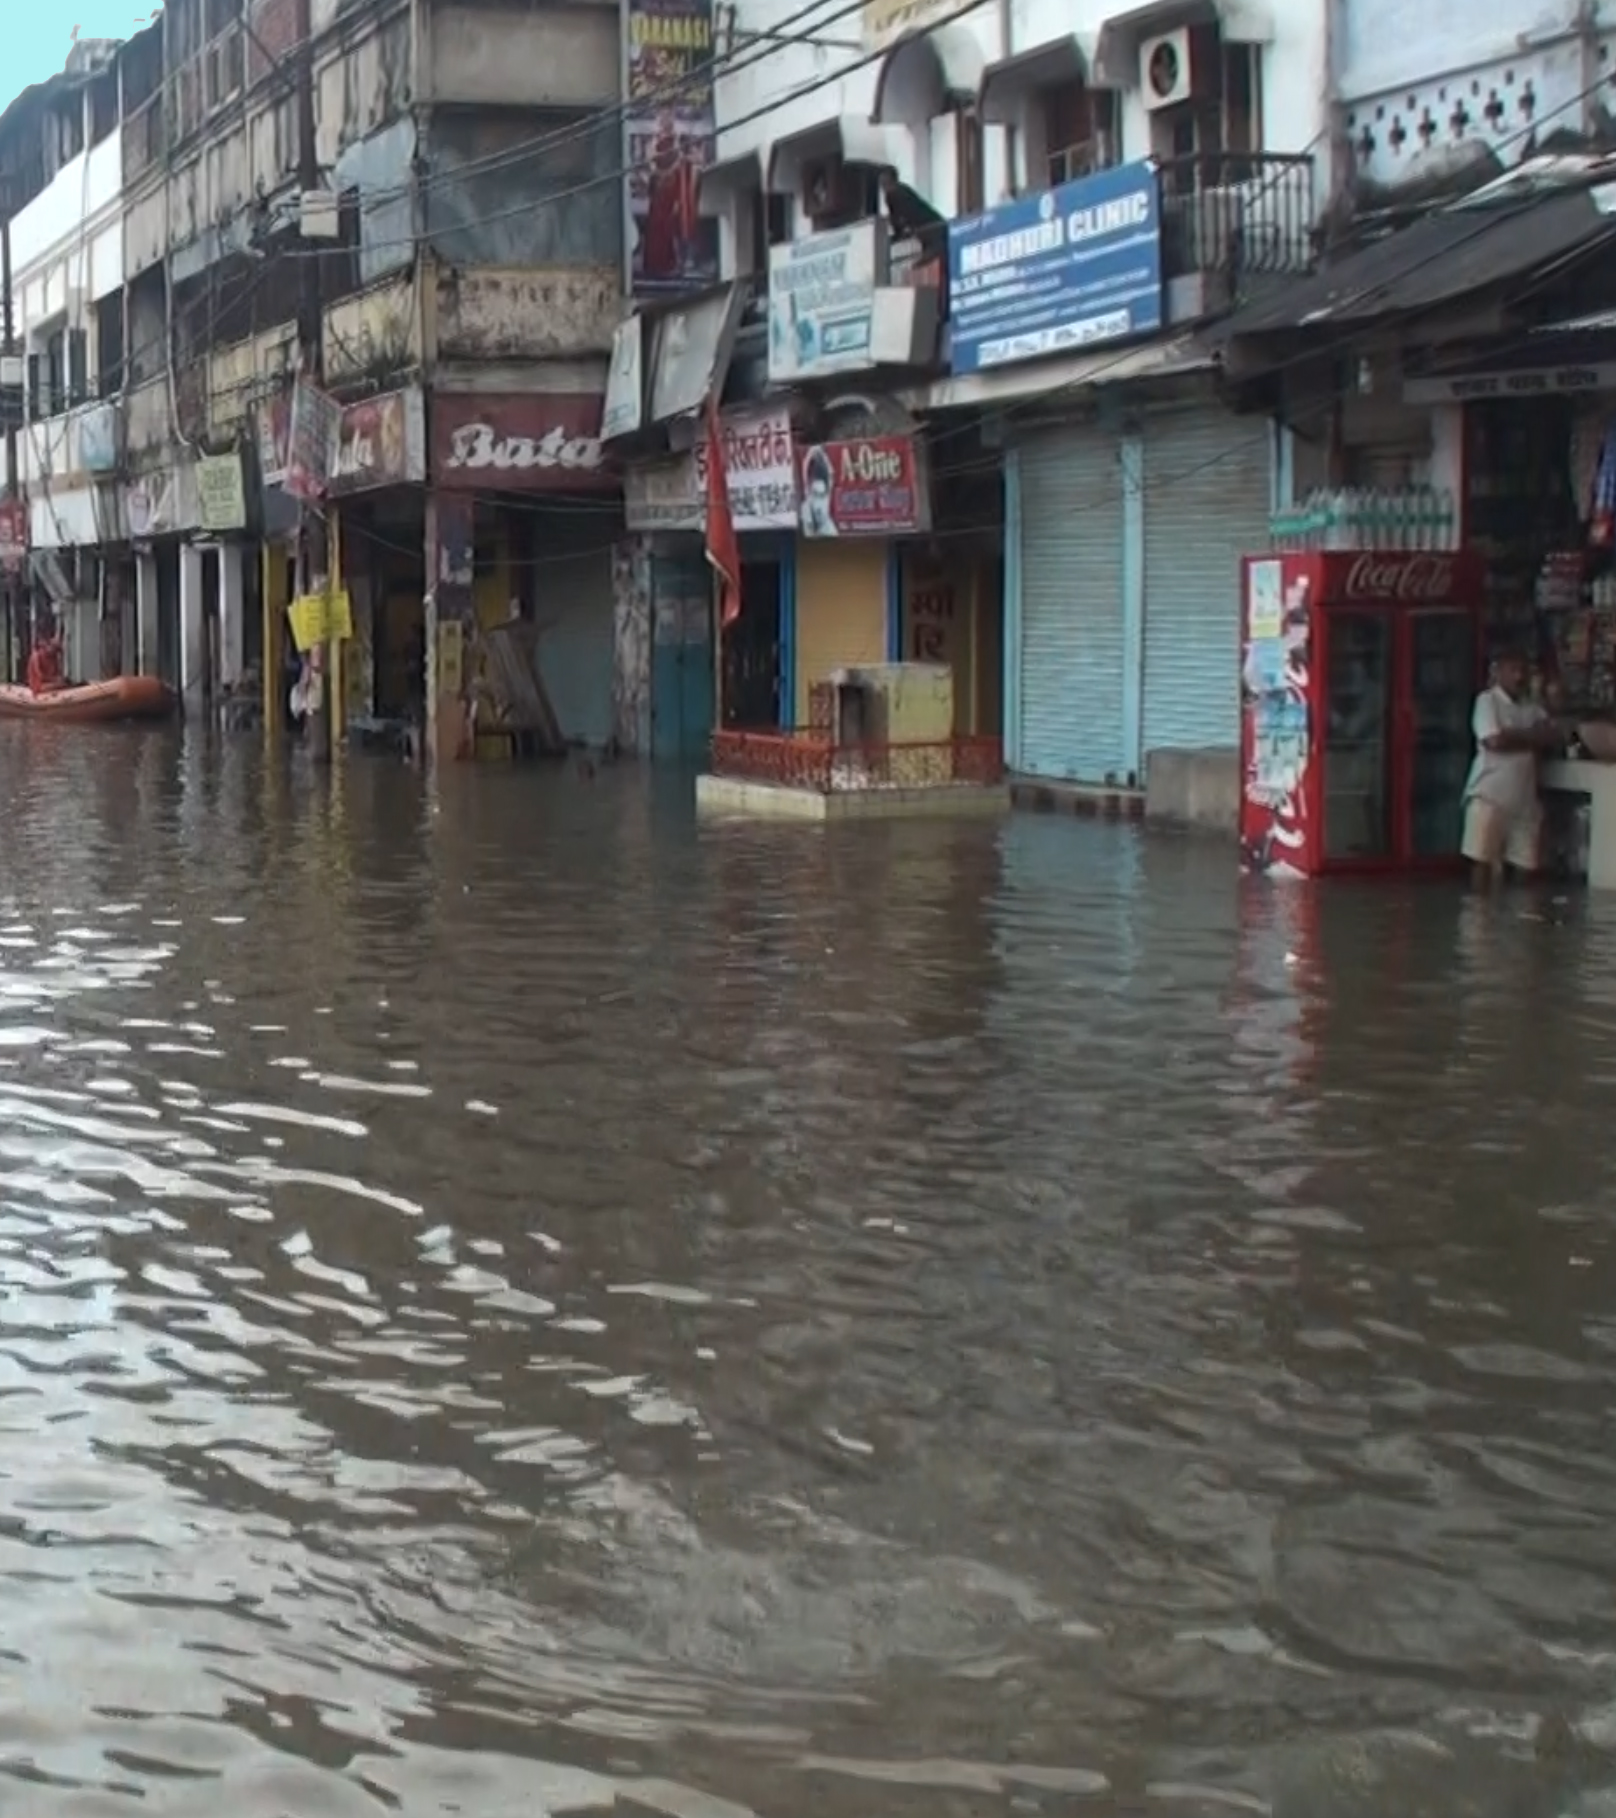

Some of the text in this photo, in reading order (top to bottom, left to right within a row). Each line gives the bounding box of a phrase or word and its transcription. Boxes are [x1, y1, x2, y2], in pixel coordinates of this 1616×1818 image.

[631, 13, 709, 48] VARANASI
[960, 217, 1064, 276] MADHURI
[1068, 189, 1149, 242] CLINIC
[447, 422, 605, 469] Bata
[840, 444, 901, 483] A-One
